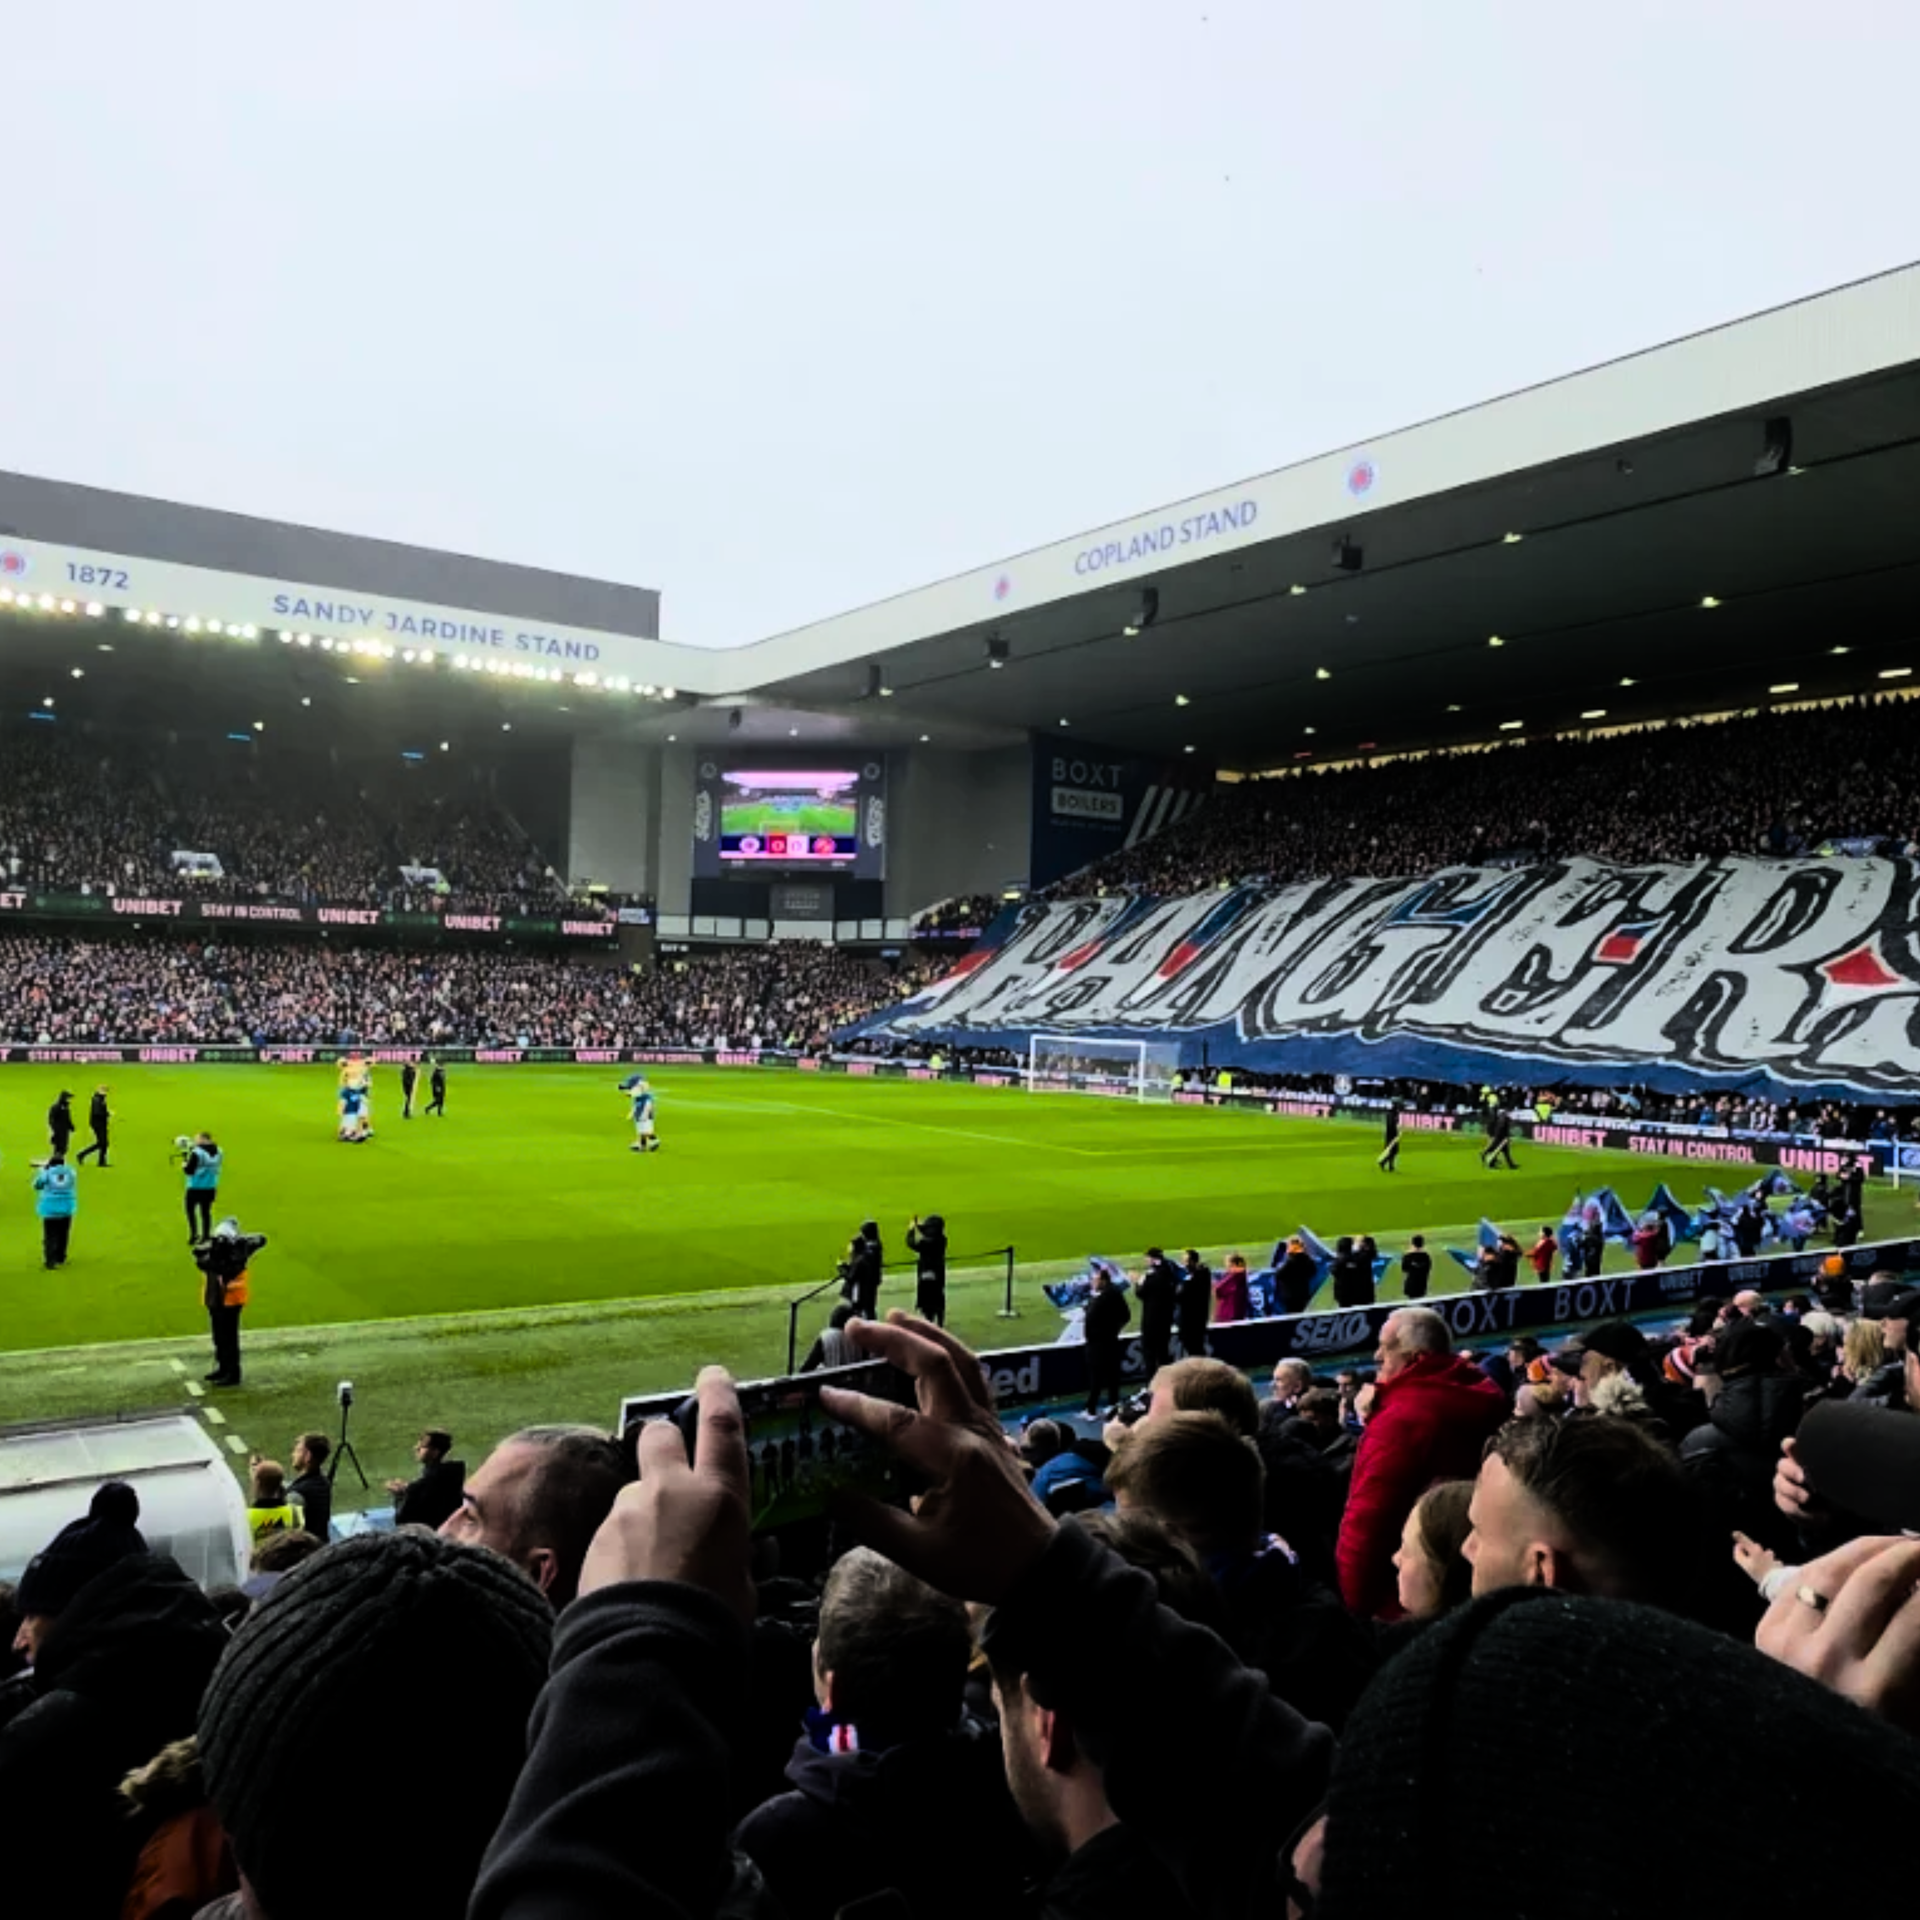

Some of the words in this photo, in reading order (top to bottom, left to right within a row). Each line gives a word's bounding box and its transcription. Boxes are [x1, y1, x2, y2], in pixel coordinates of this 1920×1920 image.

[1074, 525, 1175, 575] COPLAND
[1180, 499, 1258, 544] STAND
[66, 562, 130, 590] 1872
[273, 594, 374, 627] SANDY
[386, 613, 505, 649] JARDINE
[515, 632, 601, 663] STAND
[1051, 757, 1123, 788] BOXT
[112, 897, 183, 916] UNIBET
[200, 902, 232, 918] STAY
[233, 905, 248, 918] IN
[249, 905, 303, 921] CONTROL
[317, 907, 379, 925] UNIBET
[444, 913, 501, 931] UNIBET
[562, 920, 614, 936] UNIBET
[1532, 1125, 1609, 1149] UNIBET
[1628, 1135, 1666, 1155] STAY
[1667, 1139, 1684, 1157] IN
[1686, 1140, 1756, 1163] CONTROL
[1779, 1146, 1874, 1179] UNIBT
[1553, 1279, 1637, 1321] BOXT
[1289, 1312, 1372, 1350] SEKO
